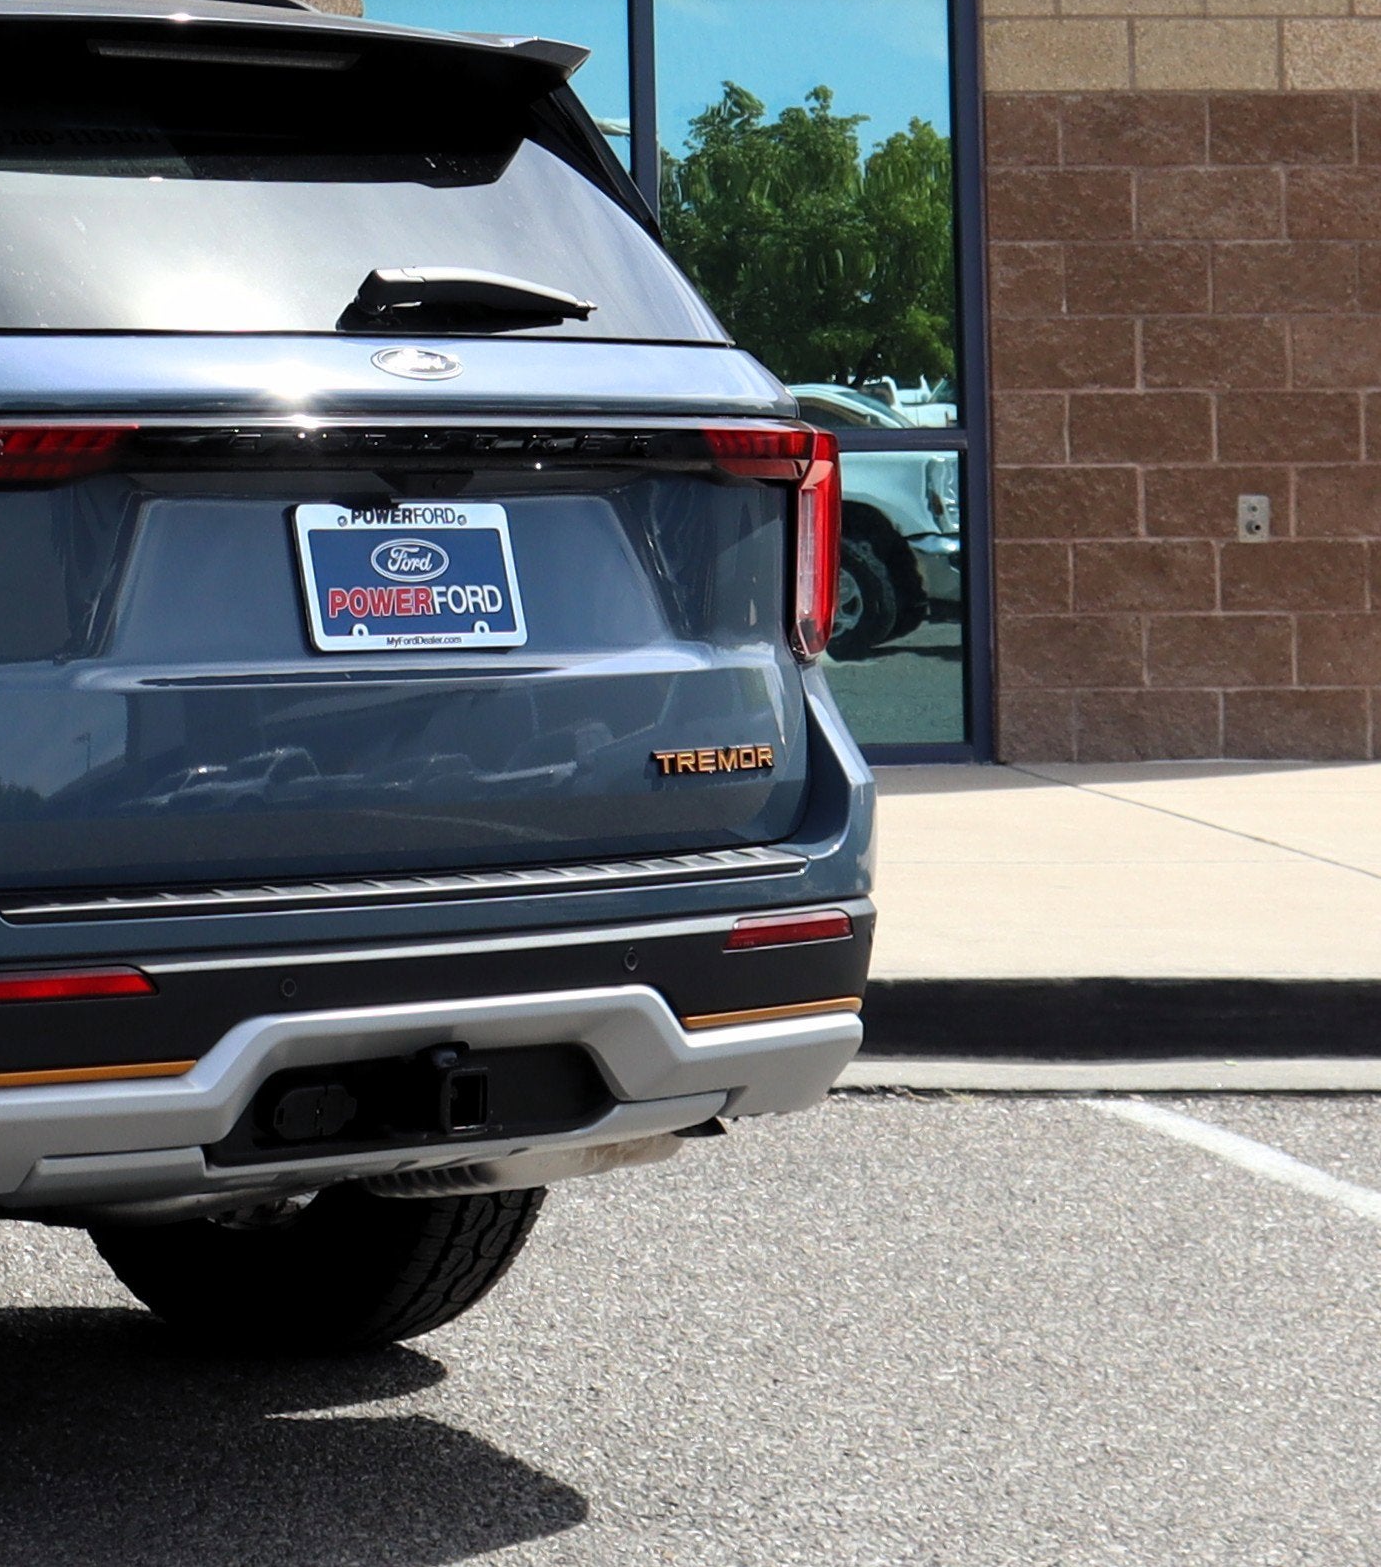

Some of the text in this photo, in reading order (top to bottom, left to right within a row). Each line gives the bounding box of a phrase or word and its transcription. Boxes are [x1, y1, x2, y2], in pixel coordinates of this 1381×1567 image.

[350, 507, 456, 525] POWERFORD
[387, 545, 433, 572] Ford
[328, 584, 503, 619] POWERFORD
[386, 635, 462, 648] MyFordDealer.com
[654, 744, 774, 775] TREMOR
